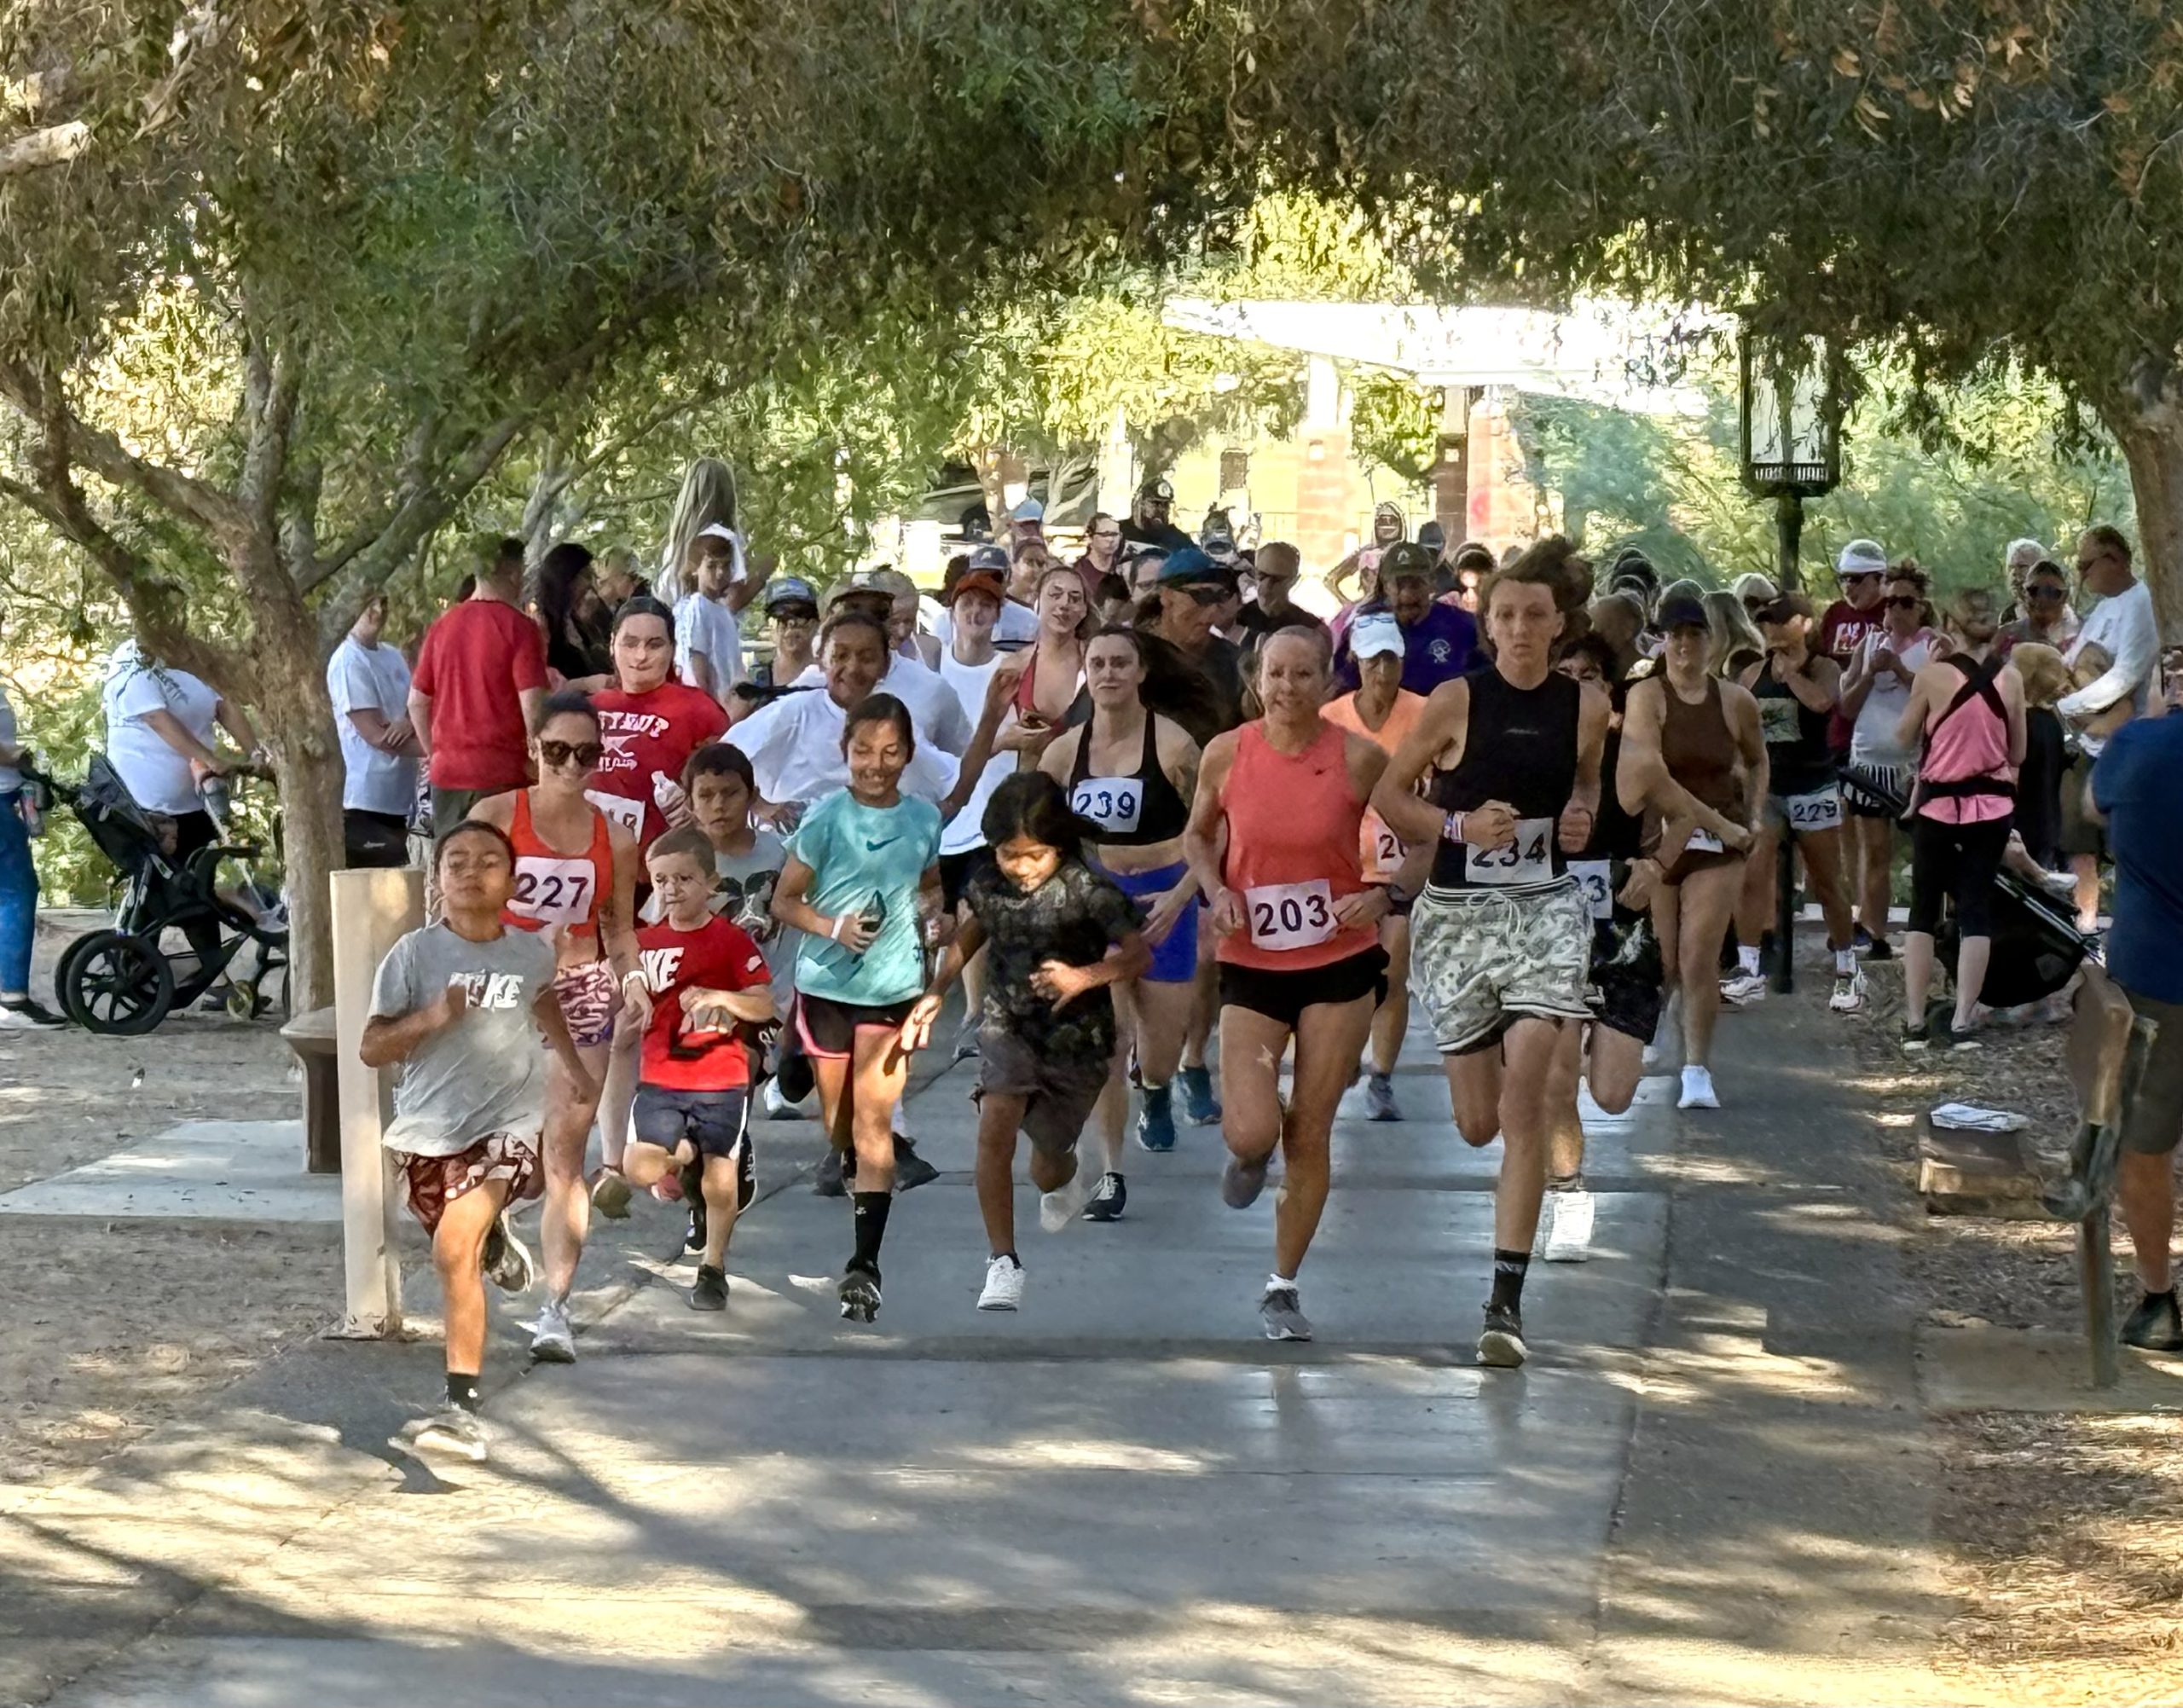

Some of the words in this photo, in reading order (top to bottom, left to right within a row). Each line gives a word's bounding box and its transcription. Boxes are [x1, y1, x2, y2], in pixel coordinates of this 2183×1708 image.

[1076, 790, 1136, 819] 239
[512, 872, 589, 908] 227
[1254, 895, 1329, 936] 203
